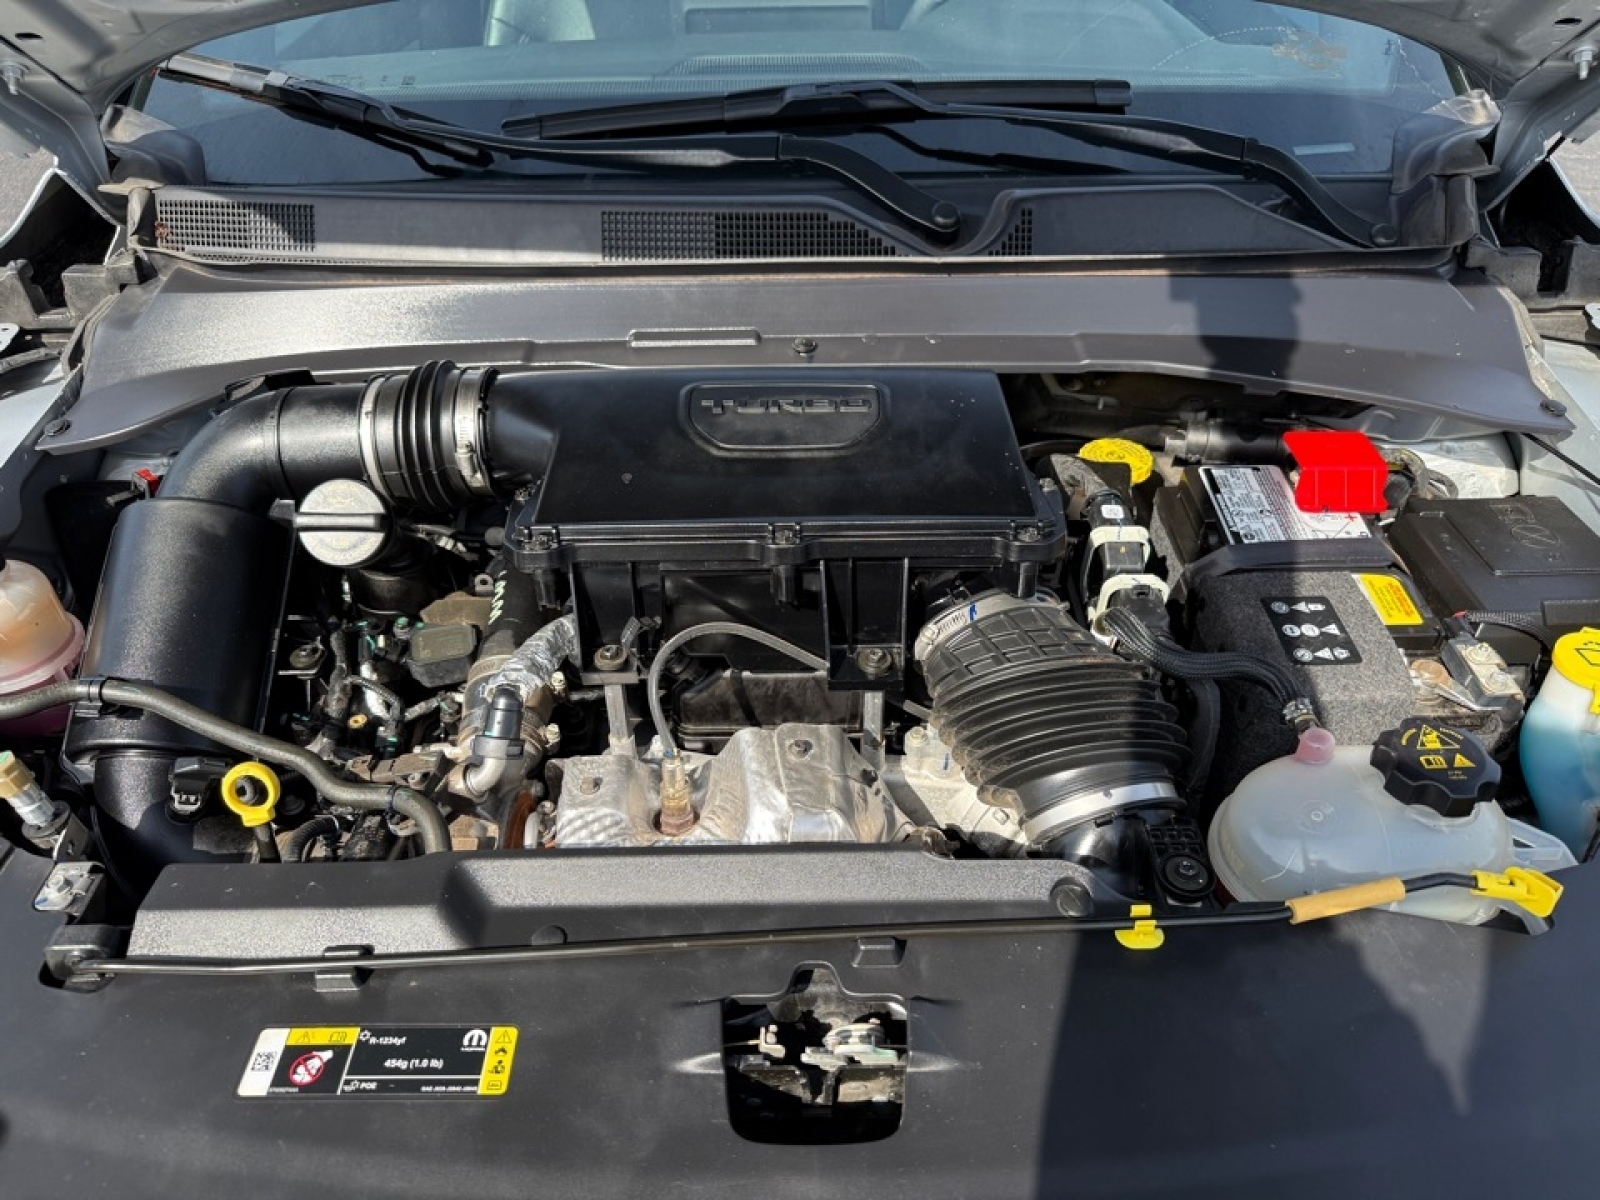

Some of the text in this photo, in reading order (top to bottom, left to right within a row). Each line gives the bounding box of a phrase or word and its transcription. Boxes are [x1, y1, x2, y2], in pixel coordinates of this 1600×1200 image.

[701, 397, 871, 414] TURBO
[369, 1036, 407, 1046] R-1234yf
[383, 1058, 444, 1070] 454g (1.0 lb)
